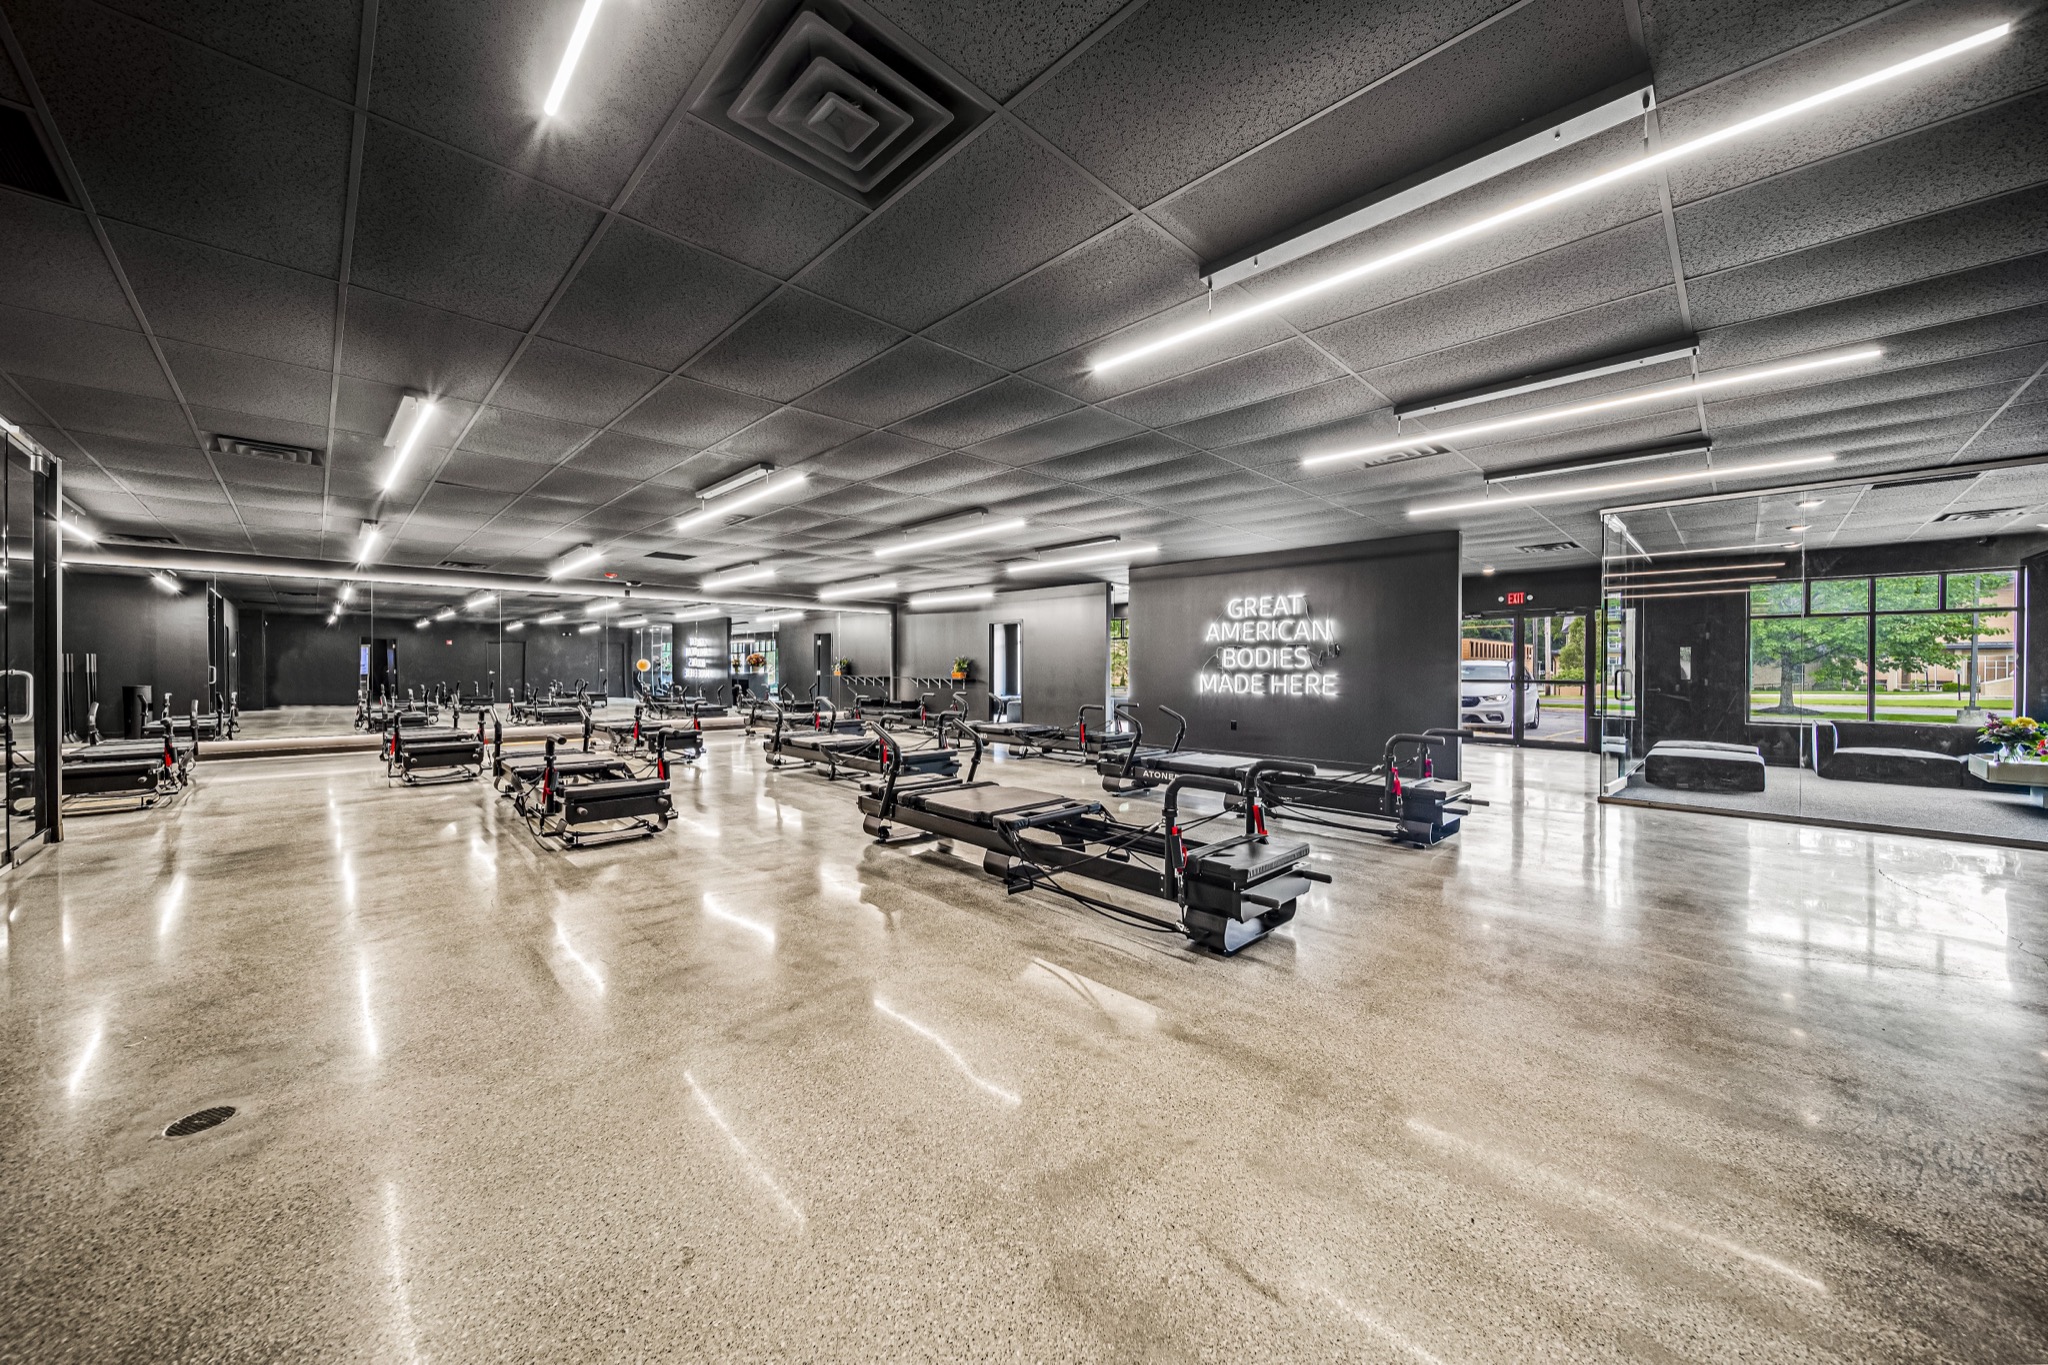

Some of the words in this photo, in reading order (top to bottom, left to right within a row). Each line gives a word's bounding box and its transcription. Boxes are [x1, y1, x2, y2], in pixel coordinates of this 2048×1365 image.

[1226, 593, 1306, 619] GREAT
[1507, 592, 1525, 605] EXIT
[1204, 618, 1331, 642] AMERICAN
[1222, 646, 1310, 669] BODIES
[1198, 673, 1264, 695] MADE
[1270, 673, 1339, 697] HERE
